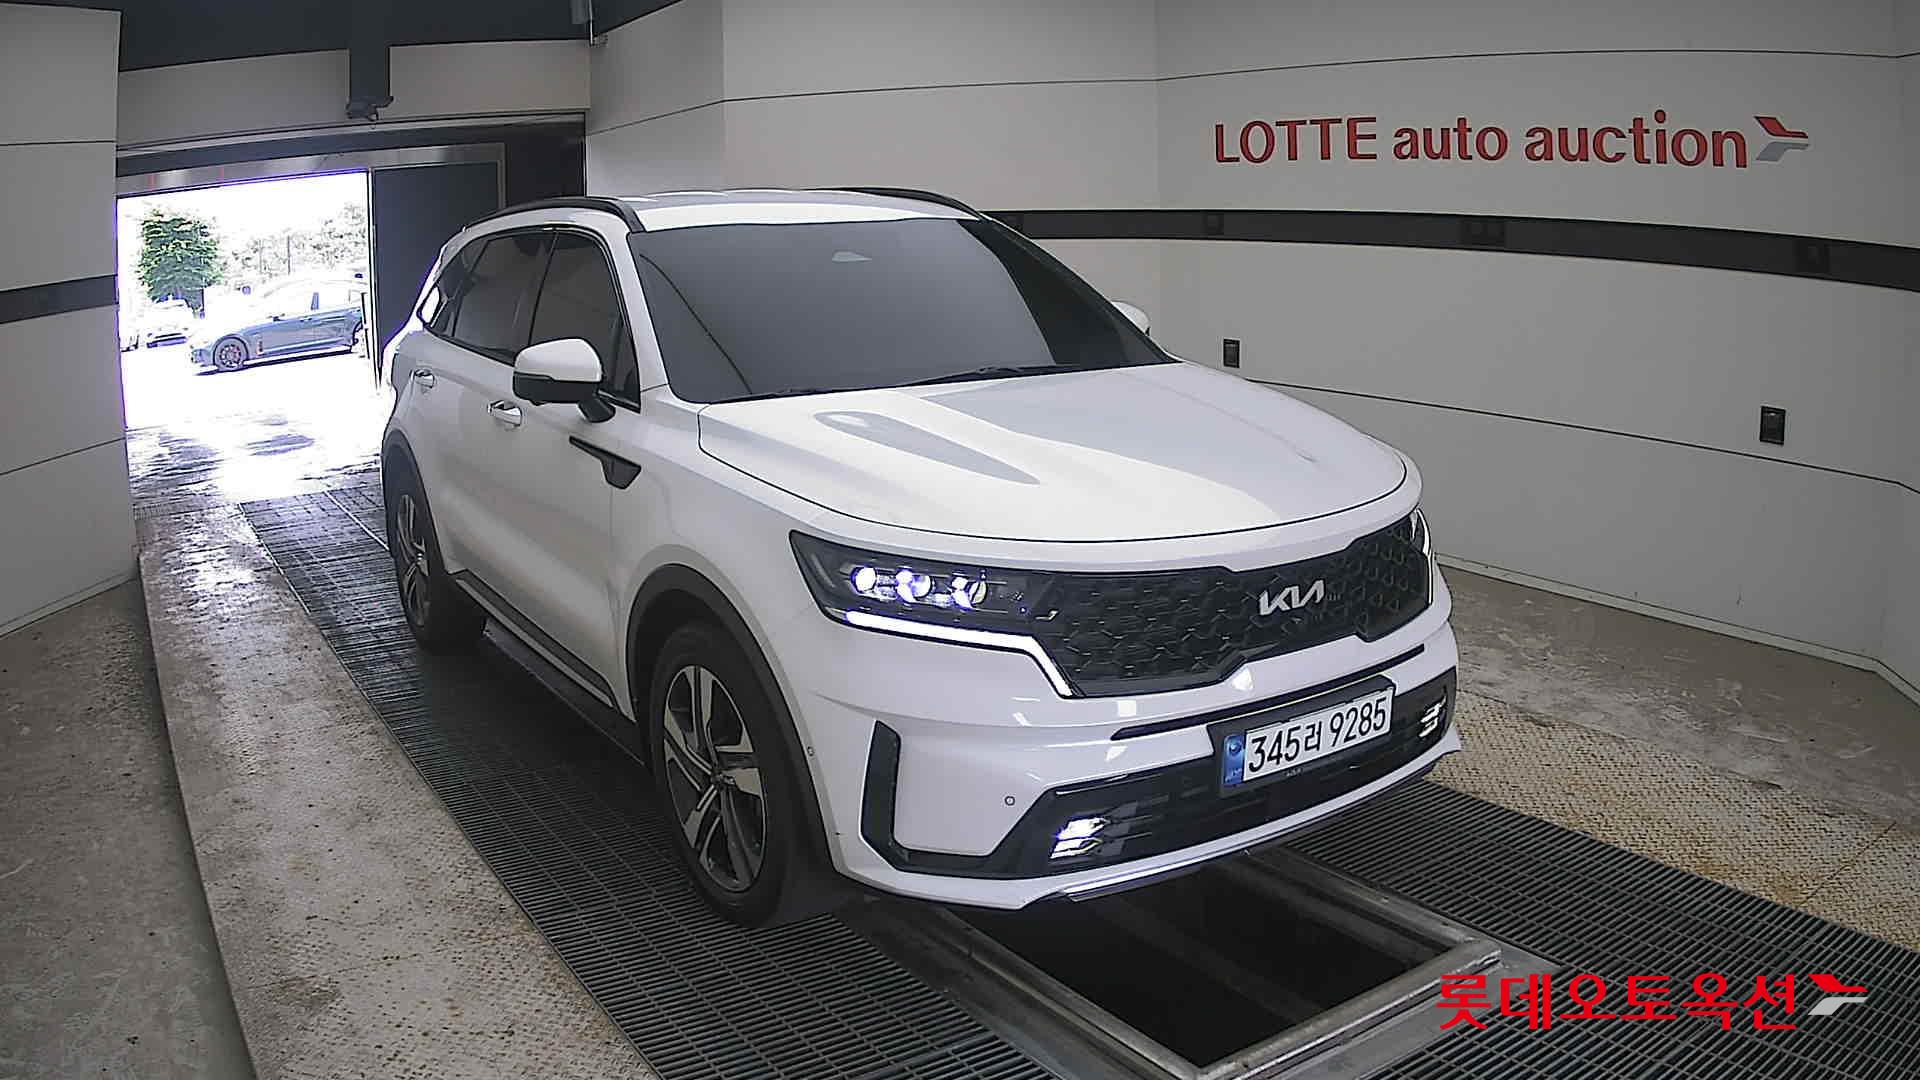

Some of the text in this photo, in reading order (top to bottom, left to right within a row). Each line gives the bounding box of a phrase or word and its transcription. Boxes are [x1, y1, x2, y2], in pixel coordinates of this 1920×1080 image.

[1214, 109, 1748, 169] LOTTE auto auction
[1259, 579, 1325, 616] KIA
[1248, 696, 1387, 773] 345러 9285
